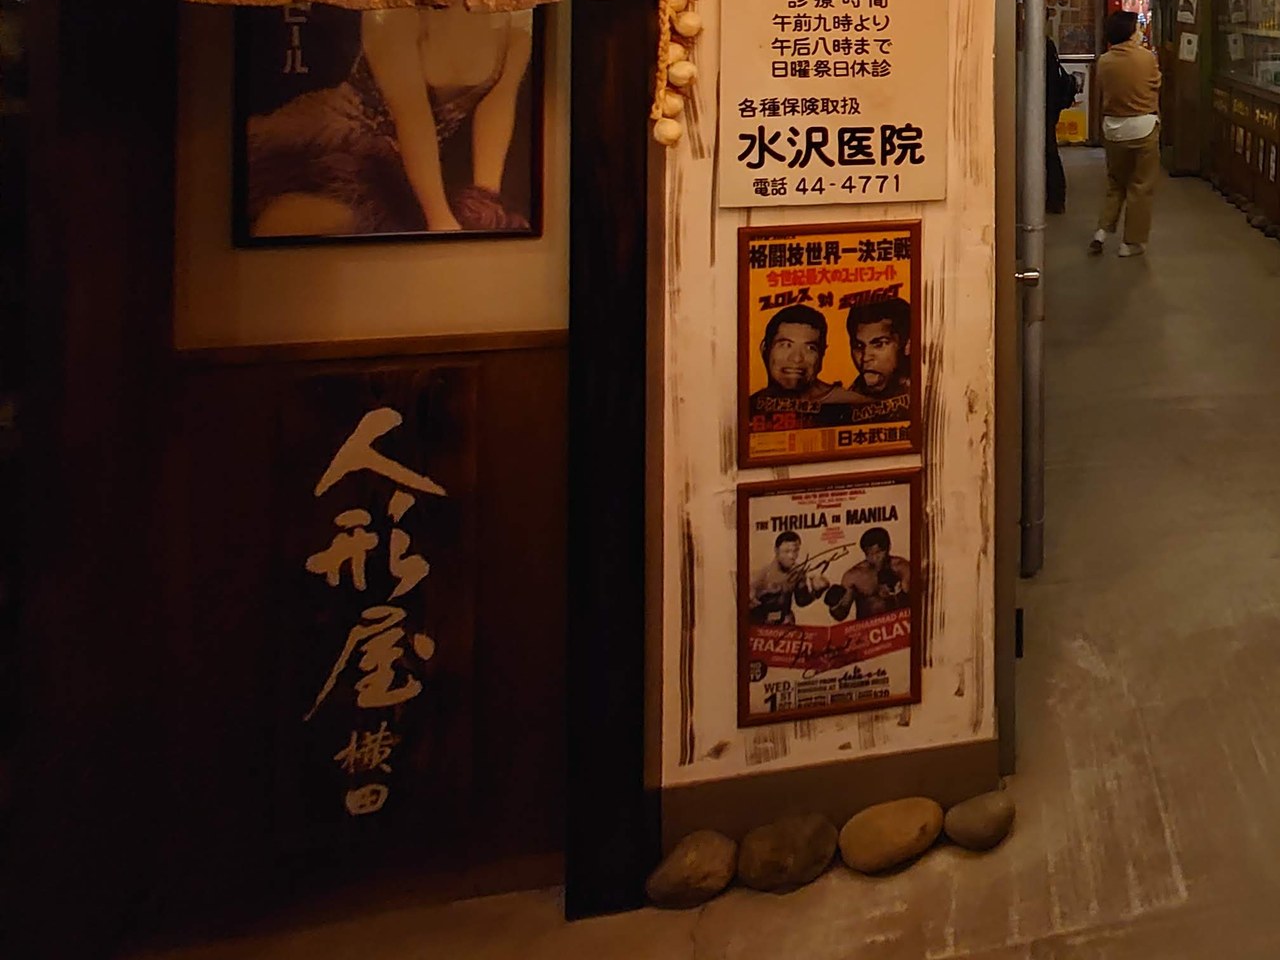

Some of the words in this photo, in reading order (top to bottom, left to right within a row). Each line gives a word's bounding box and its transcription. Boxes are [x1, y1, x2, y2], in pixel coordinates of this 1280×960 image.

[772, 13, 891, 33] 午前九時より
[771, 37, 893, 57] 午后八時まで
[771, 60, 892, 78] 日曜祭日休診
[737, 97, 861, 118] 各種保険取扱
[737, 122, 926, 169] 水沢医院
[752, 178, 788, 196] 電話
[795, 173, 901, 196] 44-4771
[770, 512, 828, 532] THRILLA
[845, 505, 898, 525] MANILA
[303, 407, 448, 722] 人形屋
[869, 620, 911, 644] CLAY
[750, 637, 813, 656] RAZIER
